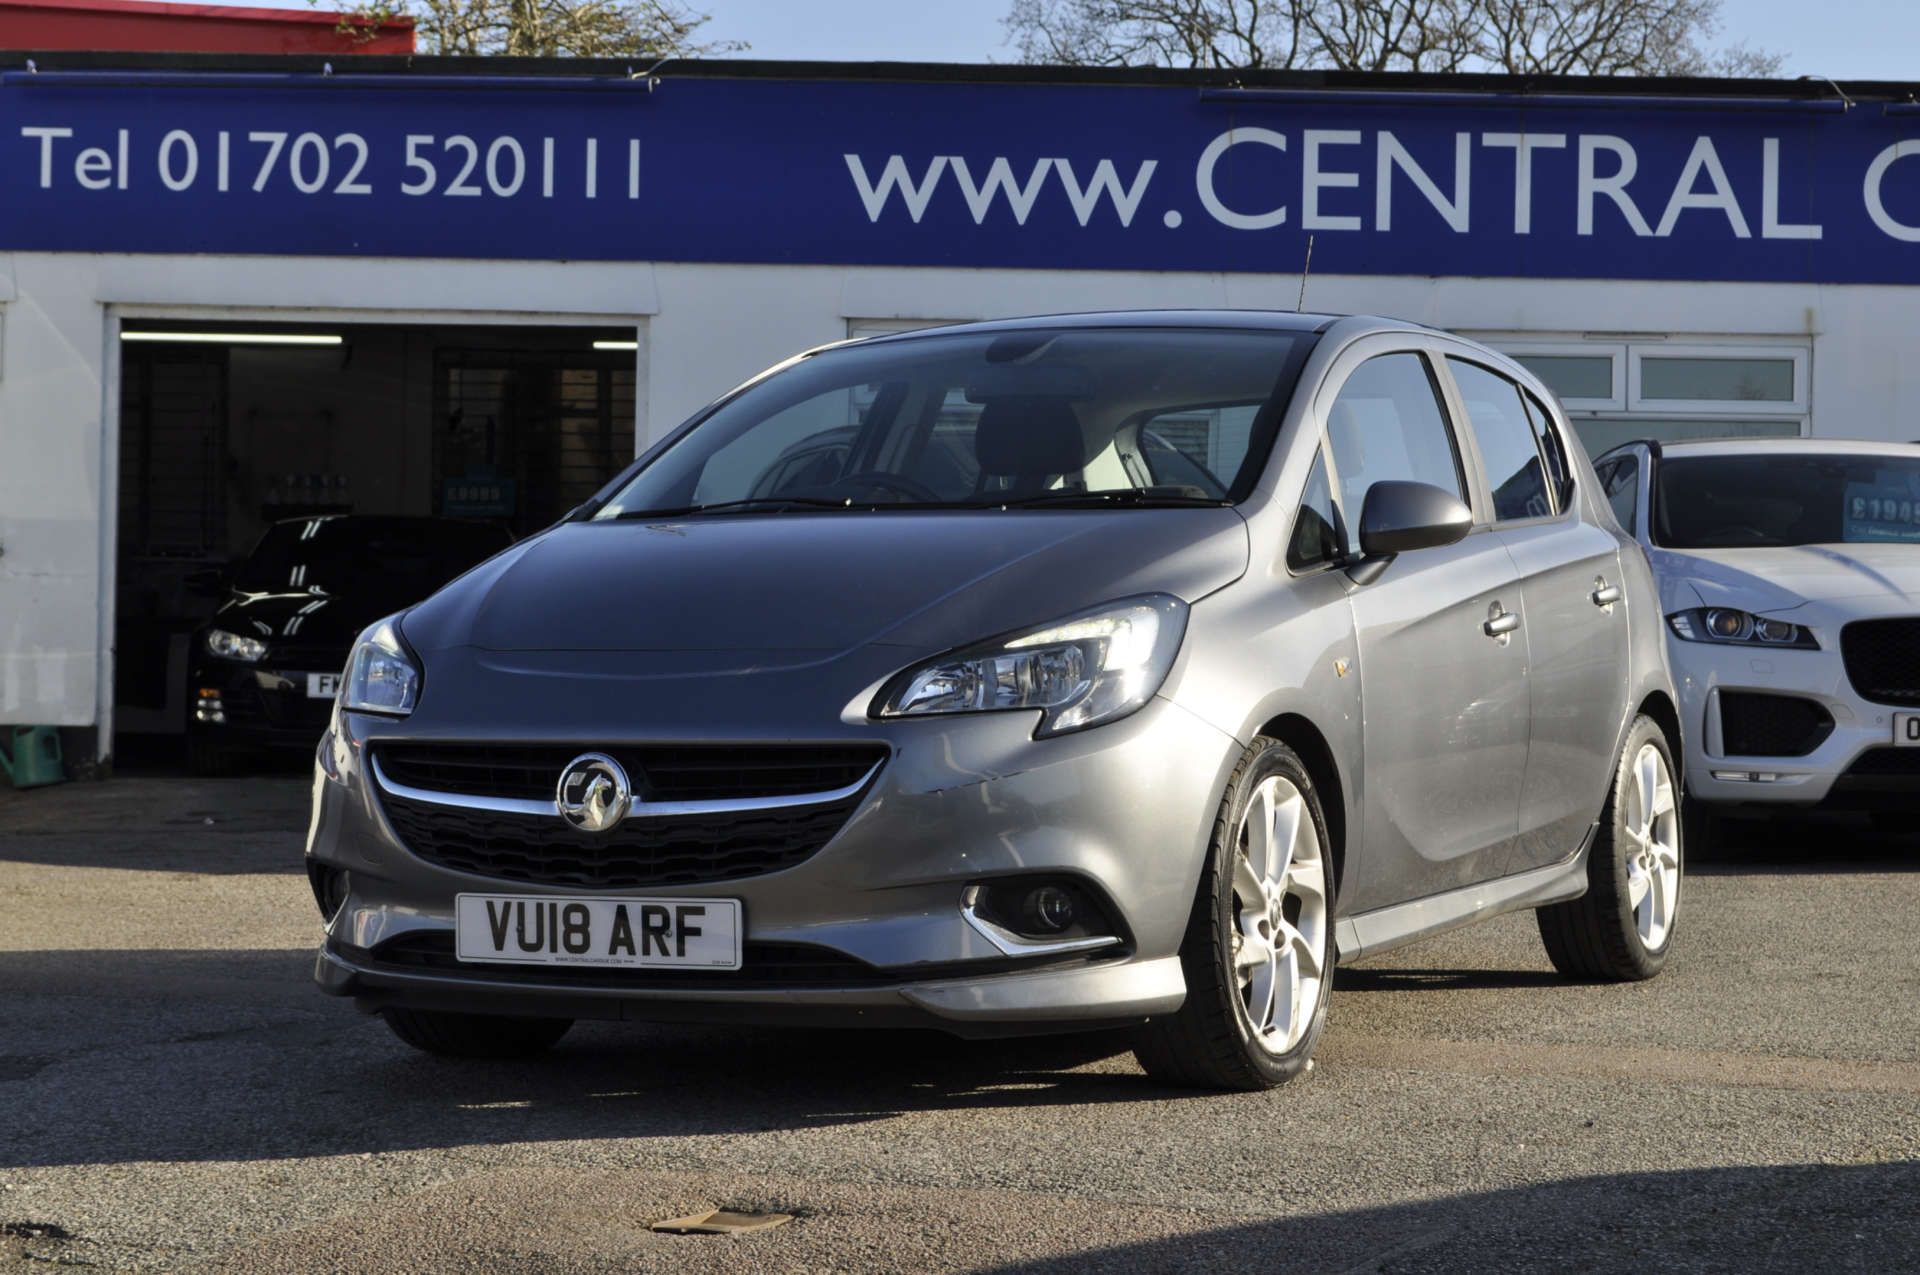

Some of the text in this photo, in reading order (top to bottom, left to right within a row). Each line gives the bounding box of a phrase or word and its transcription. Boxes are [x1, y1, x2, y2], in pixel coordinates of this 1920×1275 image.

[21, 126, 640, 199] Tel 01702 520111
[485, 900, 706, 958] VU18 ARF
